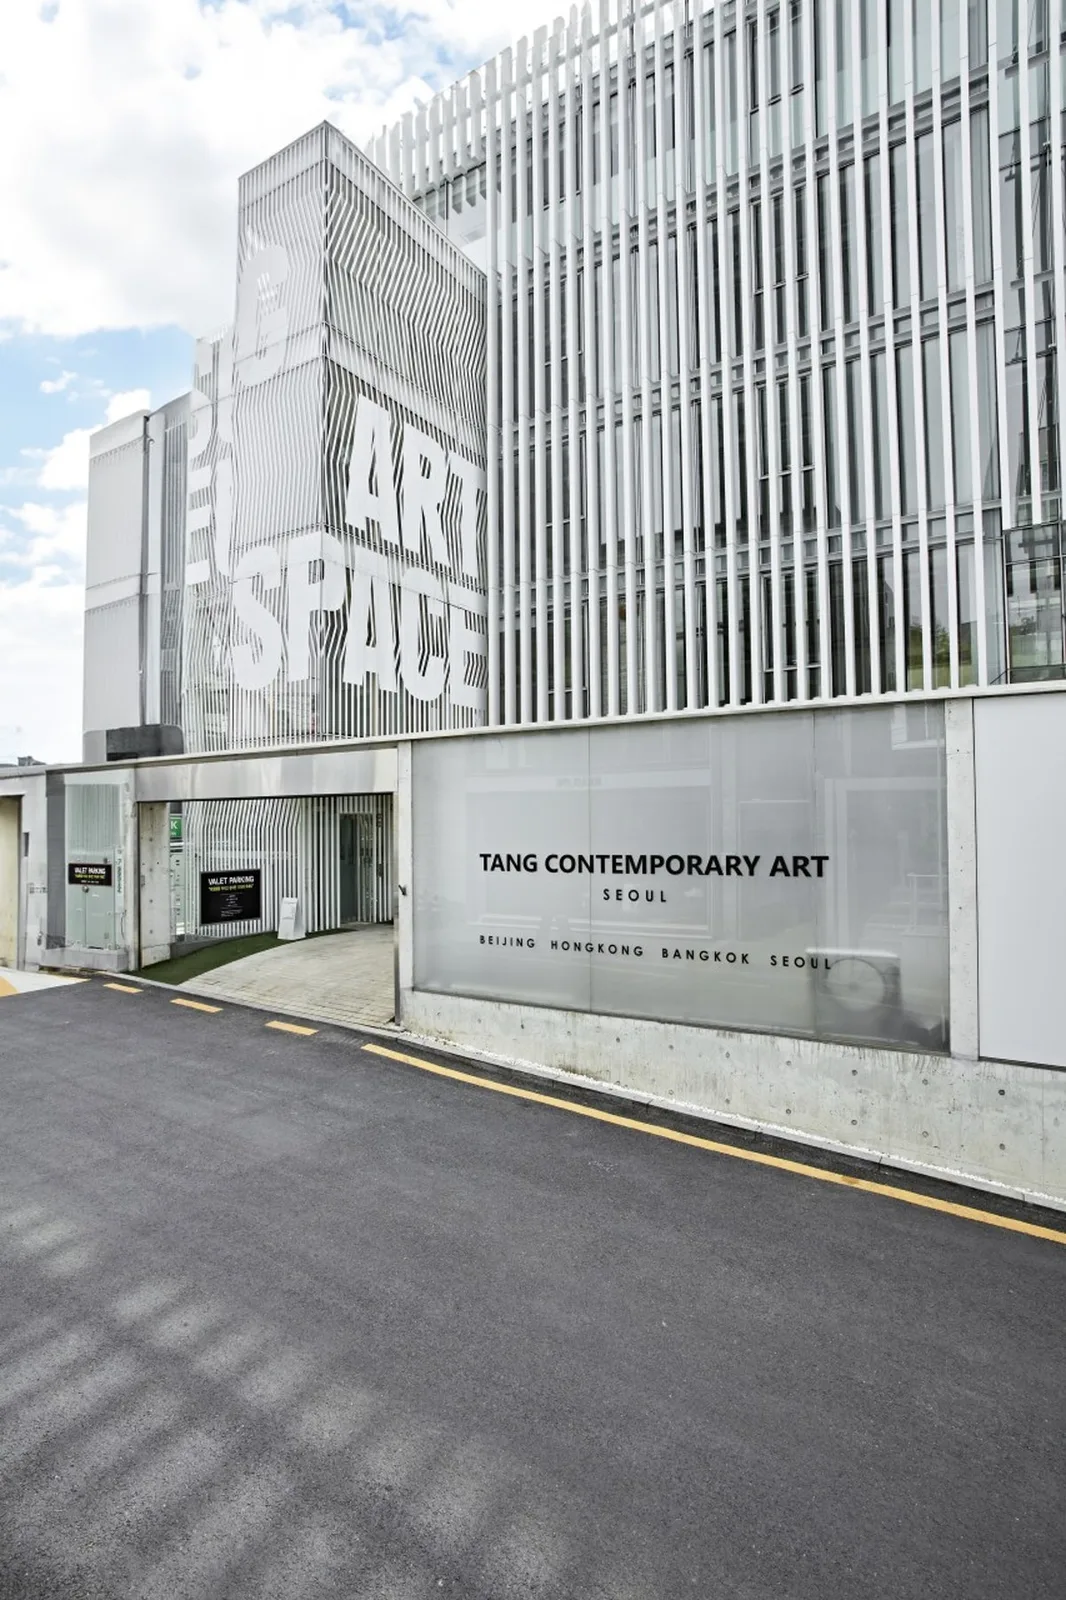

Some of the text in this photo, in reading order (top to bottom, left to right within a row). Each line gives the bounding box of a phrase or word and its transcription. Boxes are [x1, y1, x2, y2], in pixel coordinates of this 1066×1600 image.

[347, 392, 484, 580] ART
[232, 531, 485, 708] SPACE
[207, 875, 254, 885] VALET PARKING
[480, 853, 830, 879] TANG CONTEMPORARY ART
[603, 888, 668, 903] SEOUL
[479, 935, 833, 970] BEIJING HONGKONG BANGKOK SEOUL
